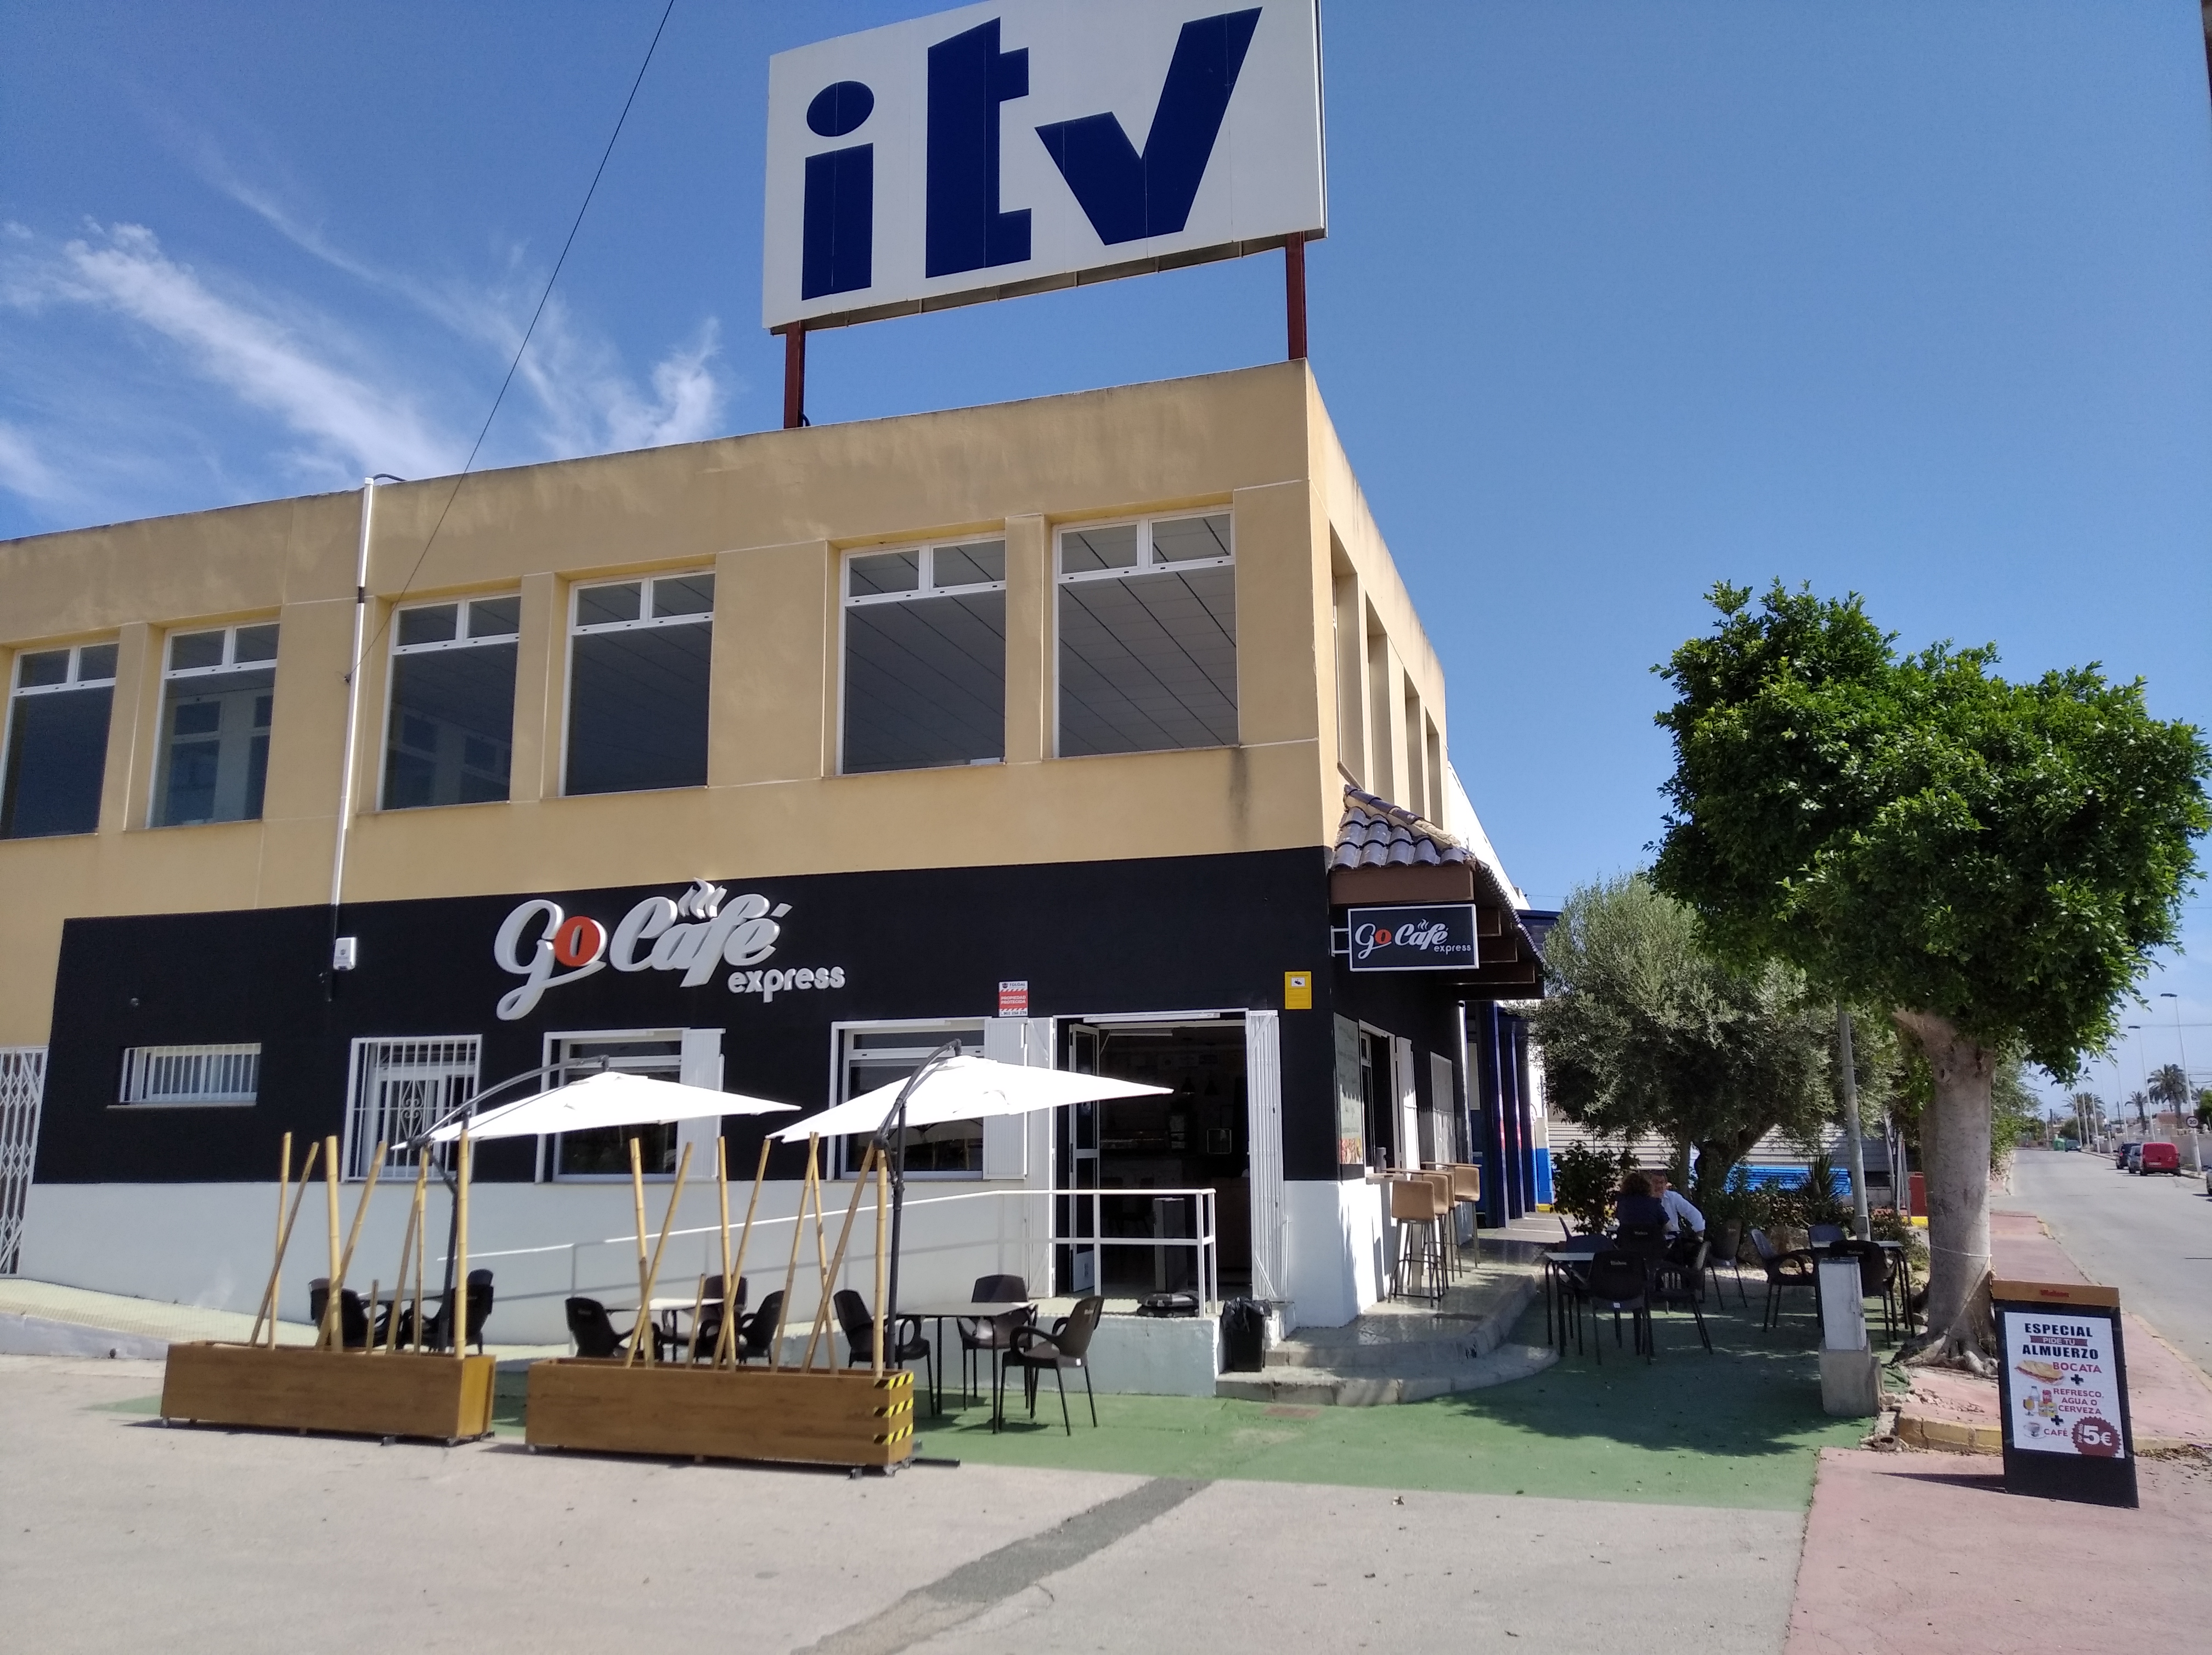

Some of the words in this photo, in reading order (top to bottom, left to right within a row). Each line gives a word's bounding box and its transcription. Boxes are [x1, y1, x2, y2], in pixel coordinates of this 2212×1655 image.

[802, 6, 1263, 300] itv
[610, 893, 793, 988] Café
[1395, 922, 1449, 950] Café
[1434, 944, 1471, 955] express
[727, 966, 846, 1003] express
[2024, 1323, 2093, 1337] ESPECIAL
[2022, 1344, 2099, 1360] ALMUERZO
[2052, 1361, 2102, 1373] BOCATA
[2053, 1388, 2104, 1398] REFRESCO,
[2061, 1398, 2088, 1406] AGUA
[2058, 1405, 2102, 1415] CERVEZA
[2044, 1428, 2068, 1437] CAFÉ
[2083, 1425, 2113, 1446] 5€
